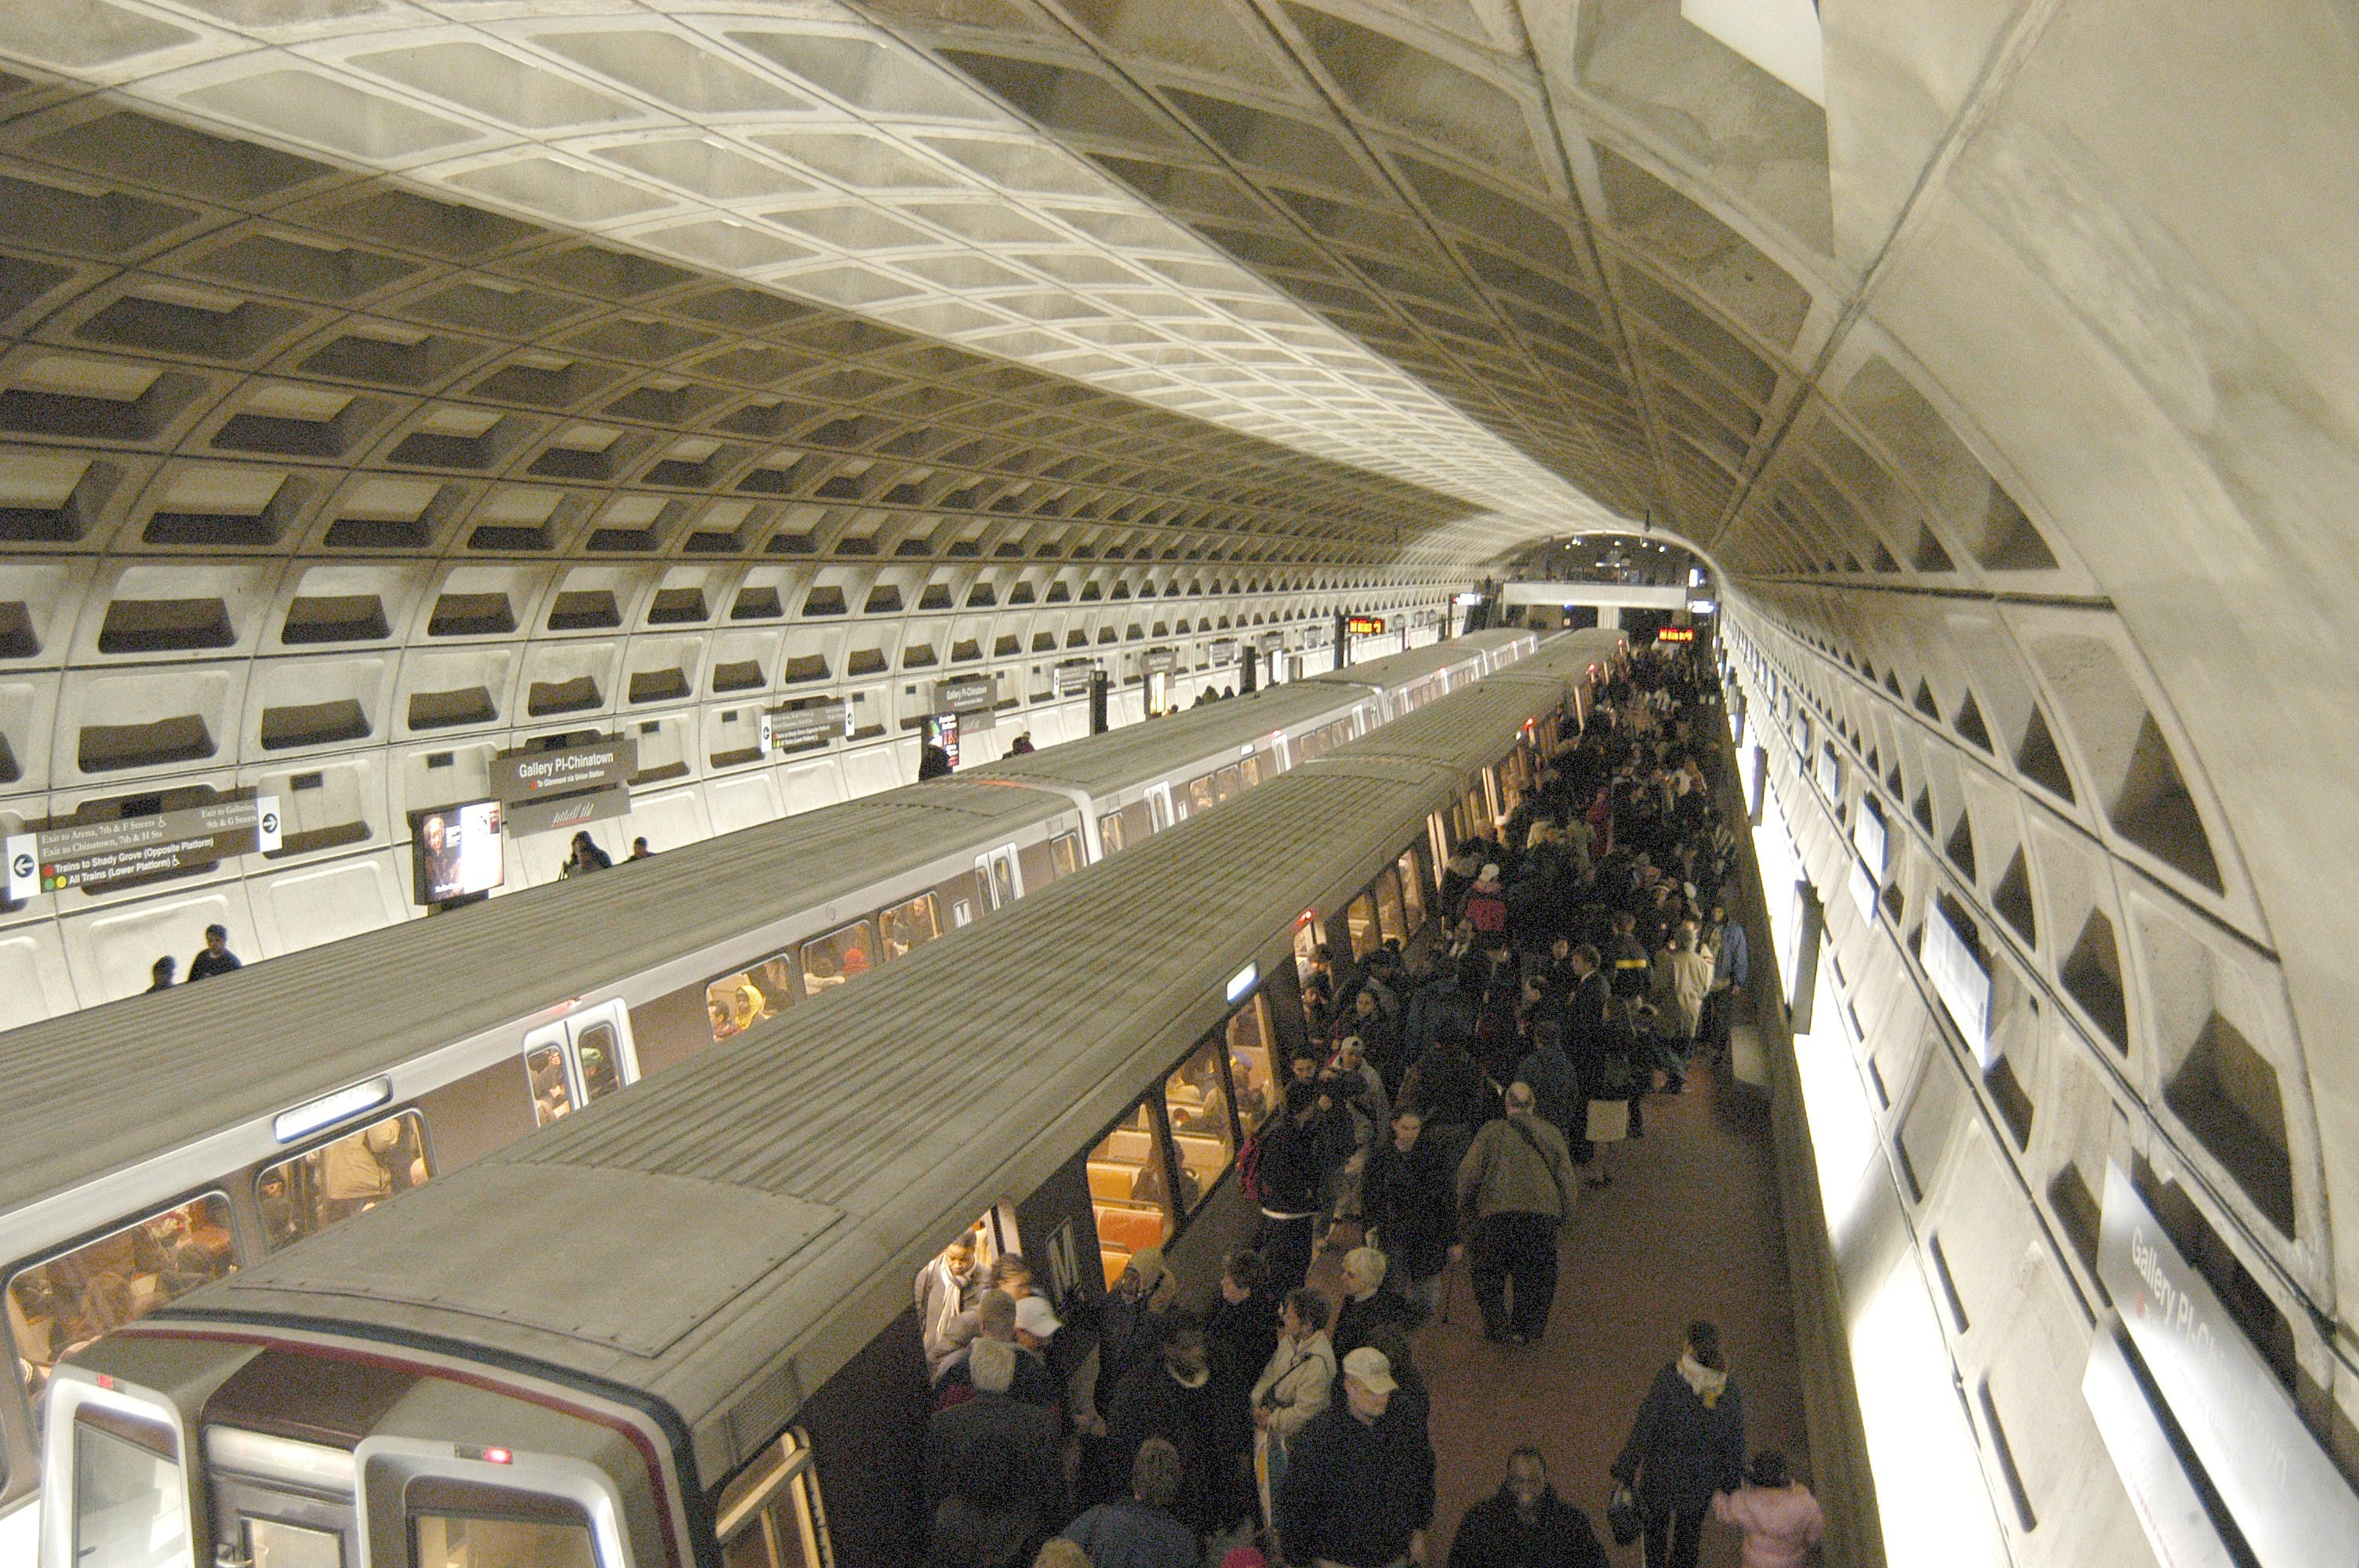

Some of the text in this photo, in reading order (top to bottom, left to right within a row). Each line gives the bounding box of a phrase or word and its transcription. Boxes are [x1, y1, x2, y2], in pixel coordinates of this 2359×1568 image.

[519, 752, 614, 779] Gallery Pl-Chinatown
[202, 809, 216, 818] Exit
[225, 803, 257, 815] Galleries,
[206, 815, 257, 829] 9th & G Streets
[42, 818, 155, 844] Exit to Arena, 7th & F Streets
[43, 847, 60, 857] Exit
[72, 839, 118, 851] Chinatown,
[118, 834, 132, 844] 7th
[133, 833, 140, 842] &
[142, 831, 150, 840] H
[151, 829, 163, 839] Sts
[55, 837, 214, 873] Trains to Shady Grove (Opposite Platform)
[69, 858, 171, 885] All Trains (Lower Platform)
[2132, 1226, 2176, 1325] Gallery
